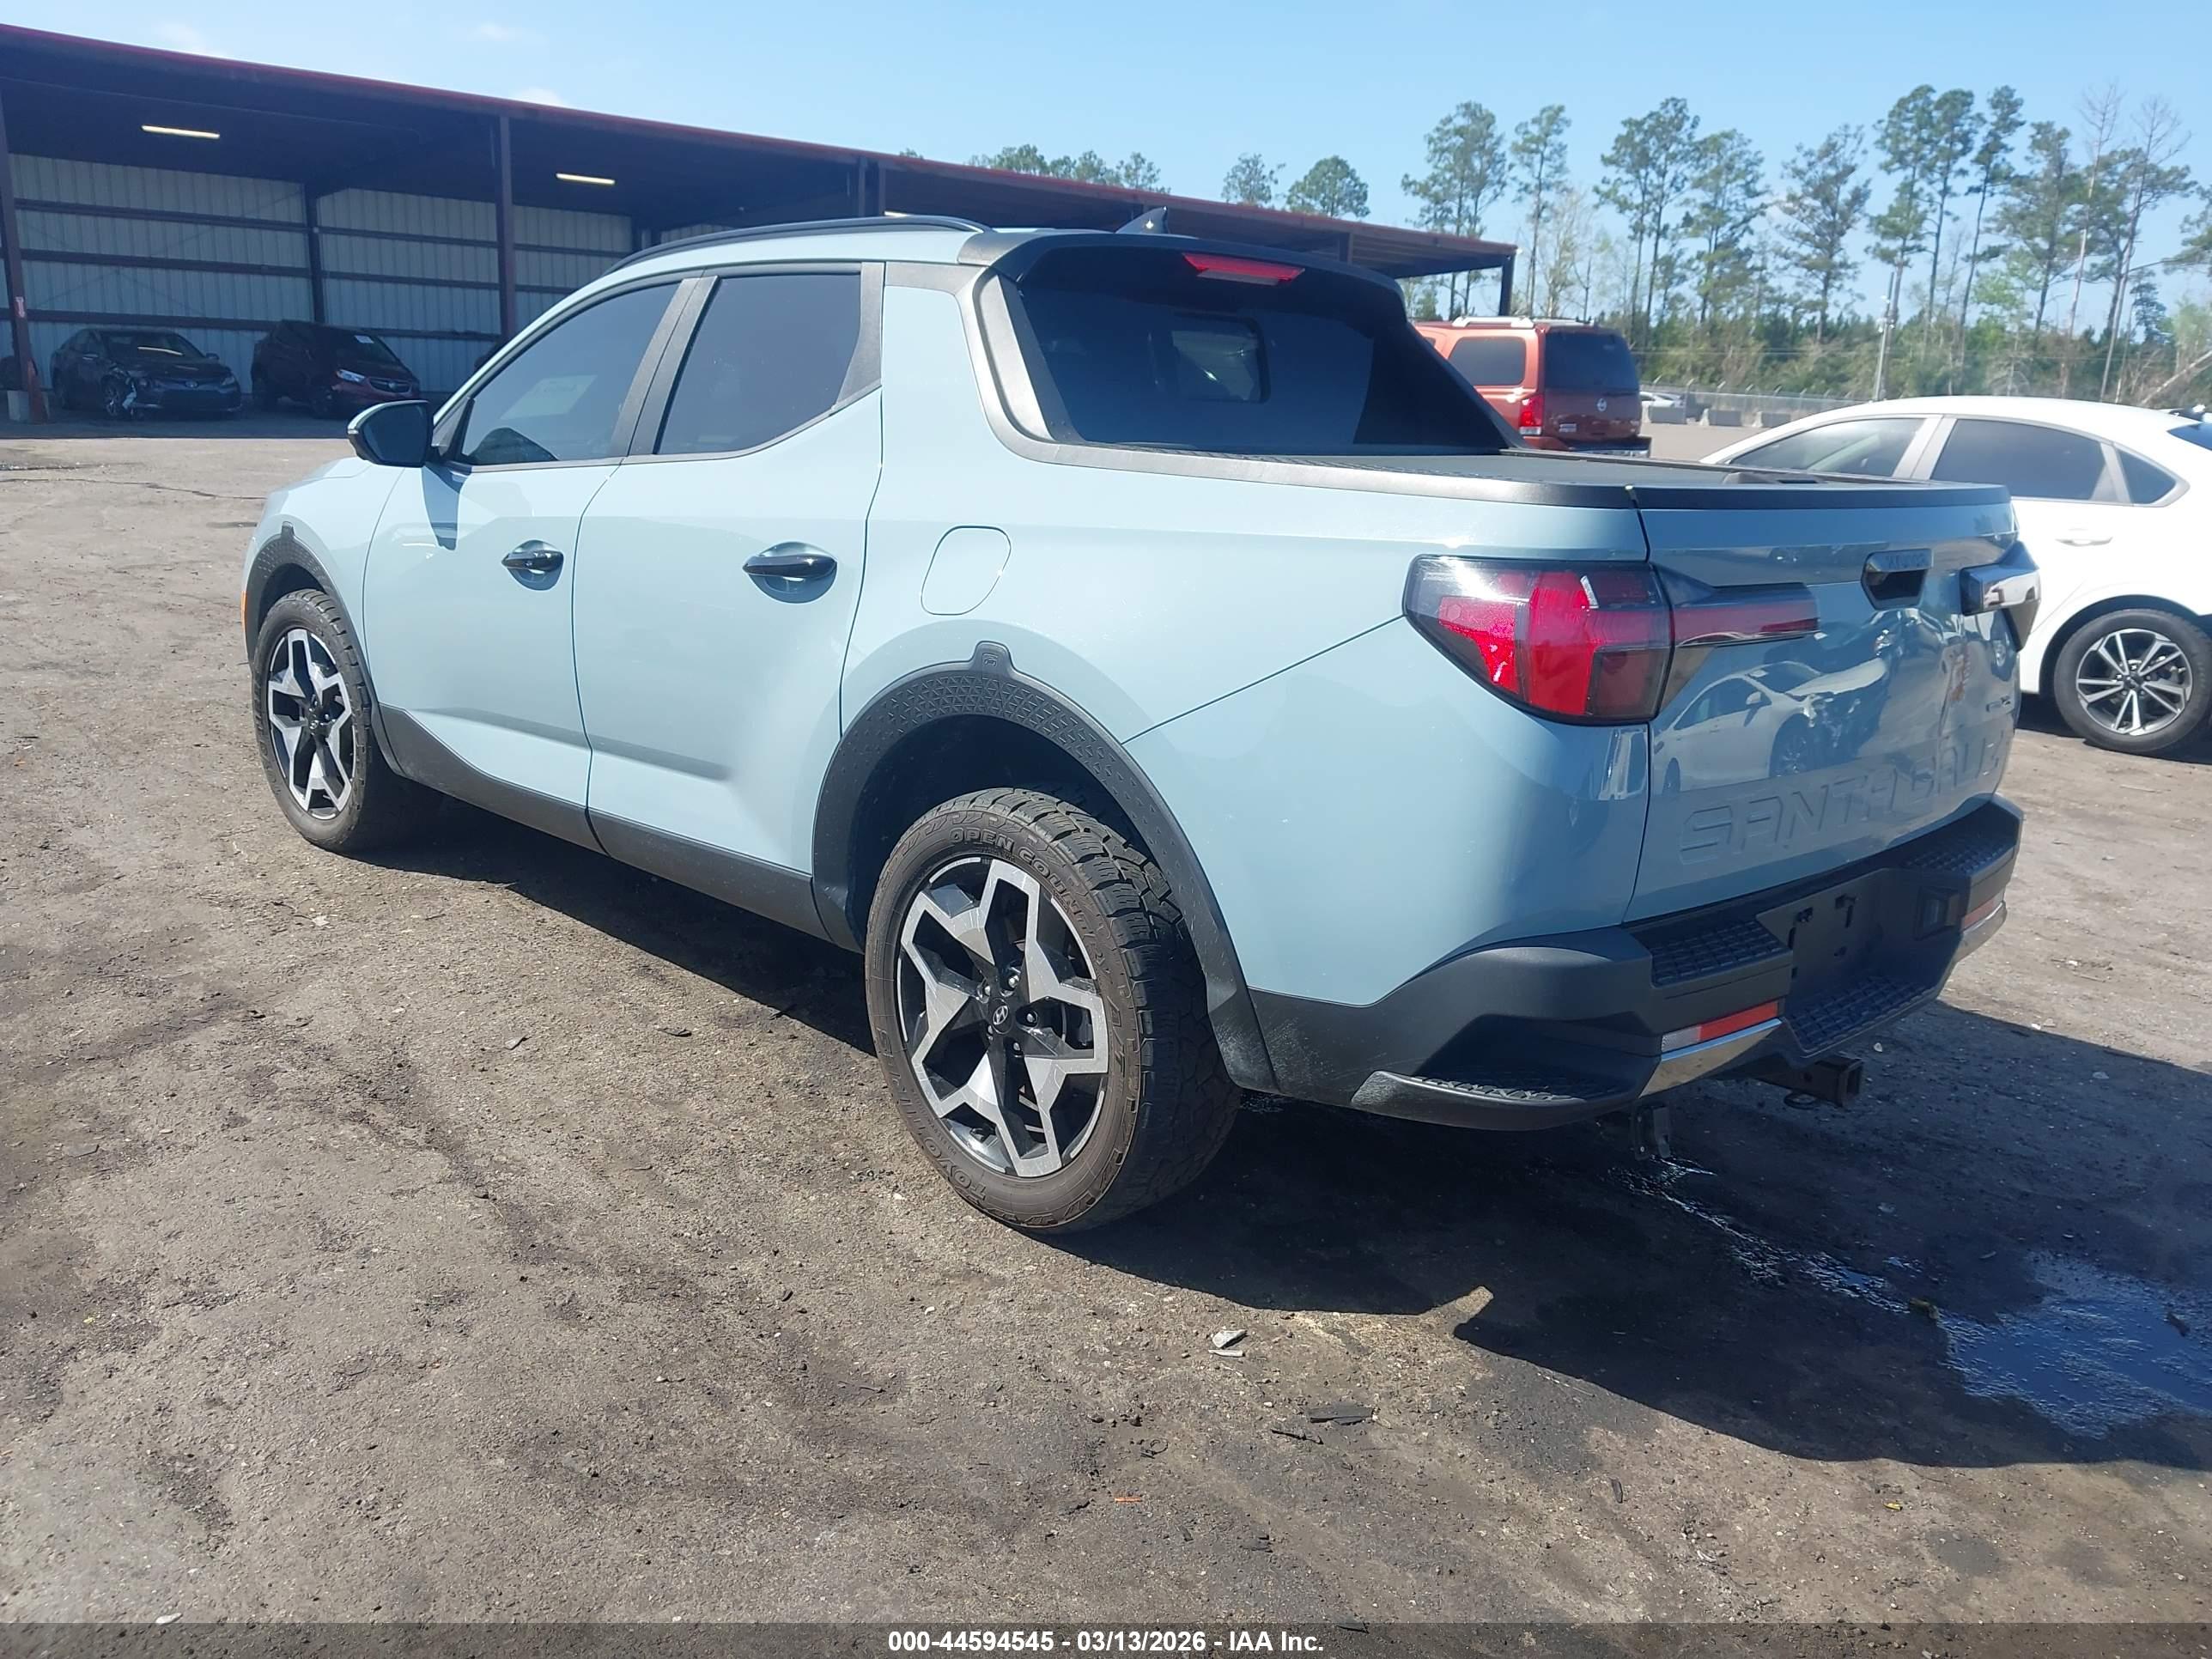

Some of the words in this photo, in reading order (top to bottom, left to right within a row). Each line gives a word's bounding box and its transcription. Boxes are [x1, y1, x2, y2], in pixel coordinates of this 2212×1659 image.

[949, 825, 1015, 854] OPEN
[1677, 766, 1898, 865] SANTA
[921, 1136, 988, 1202] TOYO
